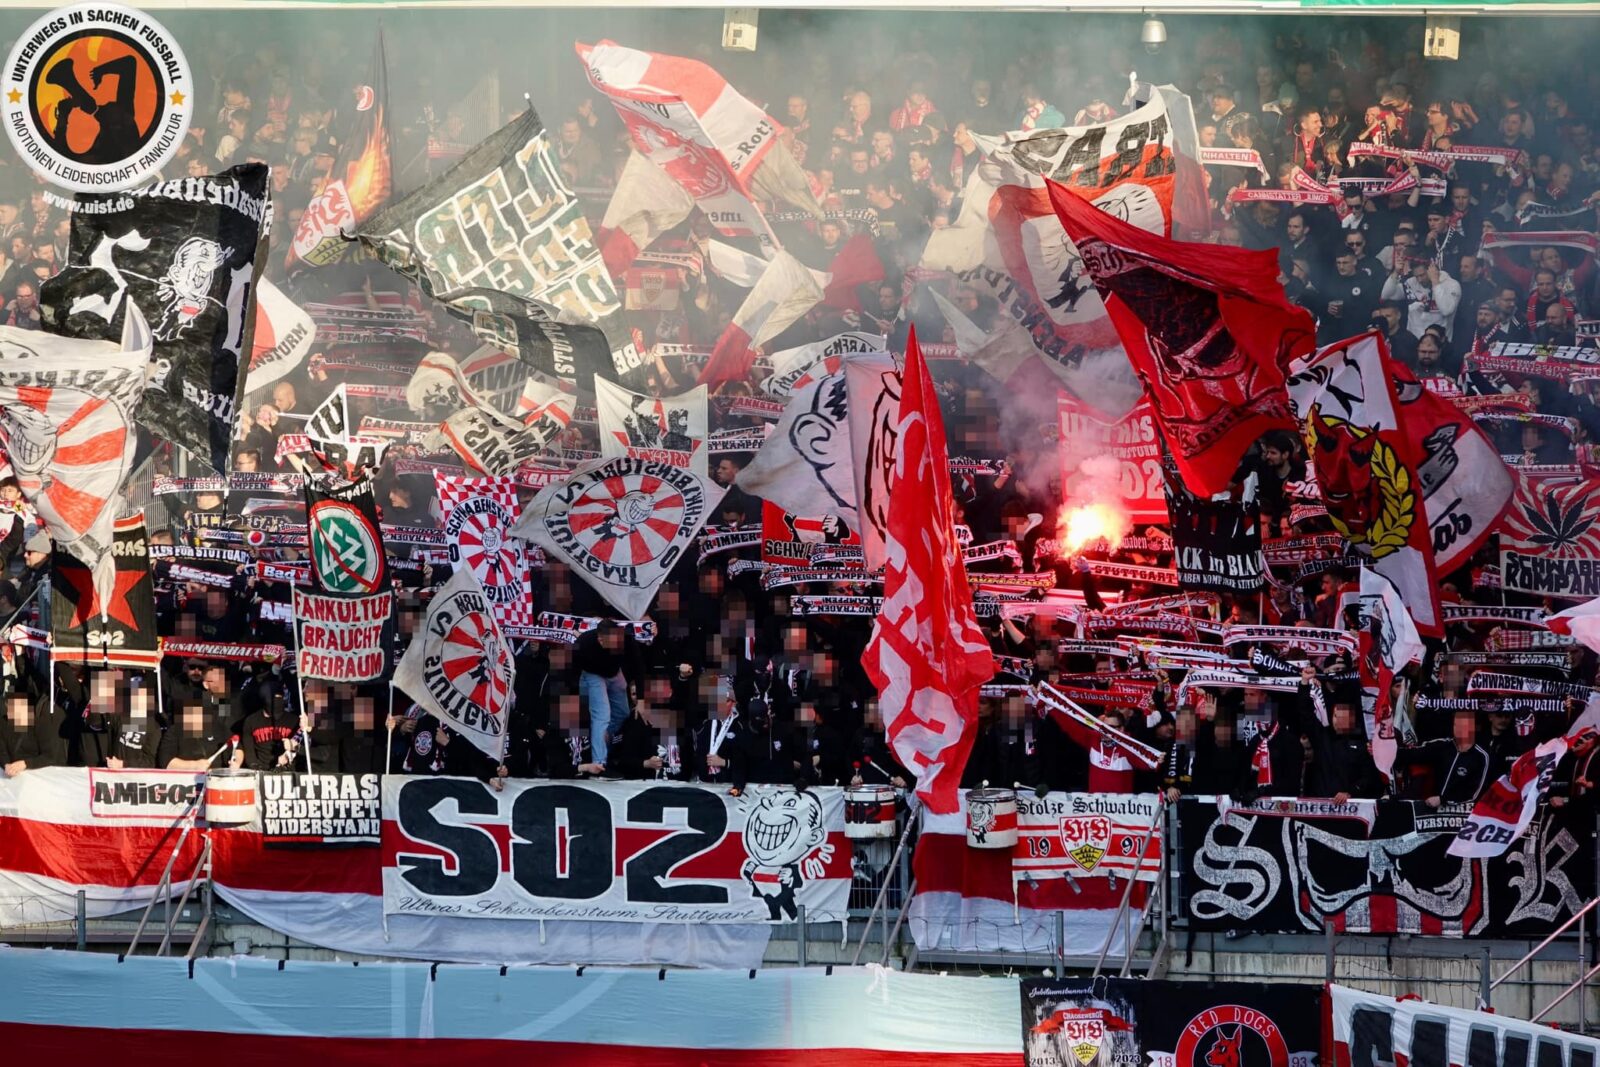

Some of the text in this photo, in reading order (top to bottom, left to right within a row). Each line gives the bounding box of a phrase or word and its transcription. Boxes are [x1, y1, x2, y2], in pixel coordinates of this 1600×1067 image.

[111, 540, 147, 557] RAS
[717, 531, 758, 548] IMMER
[835, 550, 863, 558] HEISS
[263, 564, 296, 581] Bad
[1506, 551, 1600, 577] SCHWABE
[790, 573, 826, 582] HEISST
[1094, 565, 1178, 584] STUTTGART
[1505, 567, 1600, 596] KOMPAN
[294, 591, 391, 623] FANKULTUR
[1441, 606, 1533, 620] STUTTGART
[1088, 620, 1116, 629] BAD
[304, 625, 382, 651] BRAUCHT
[1246, 628, 1341, 642] STUTTGART
[1531, 630, 1578, 647] 189
[301, 651, 383, 678] FREIRAUM
[1471, 674, 1592, 701] SCHWABEN KOMPANIE
[1414, 693, 1479, 711] Schwaben
[264, 775, 379, 800] ULTRAS
[265, 799, 380, 819] BEDEUTET
[1016, 796, 1153, 817] Stolze Schwaben
[264, 818, 381, 836] WIDERSTAND
[1027, 837, 1051, 858] 19
[400, 896, 756, 923] Ultras Schwabensturm Stuttgart
[1189, 1006, 1276, 1038] RED DOGS
[1115, 1054, 1141, 1065] 2023
[1158, 1056, 1307, 1067] 18 93
